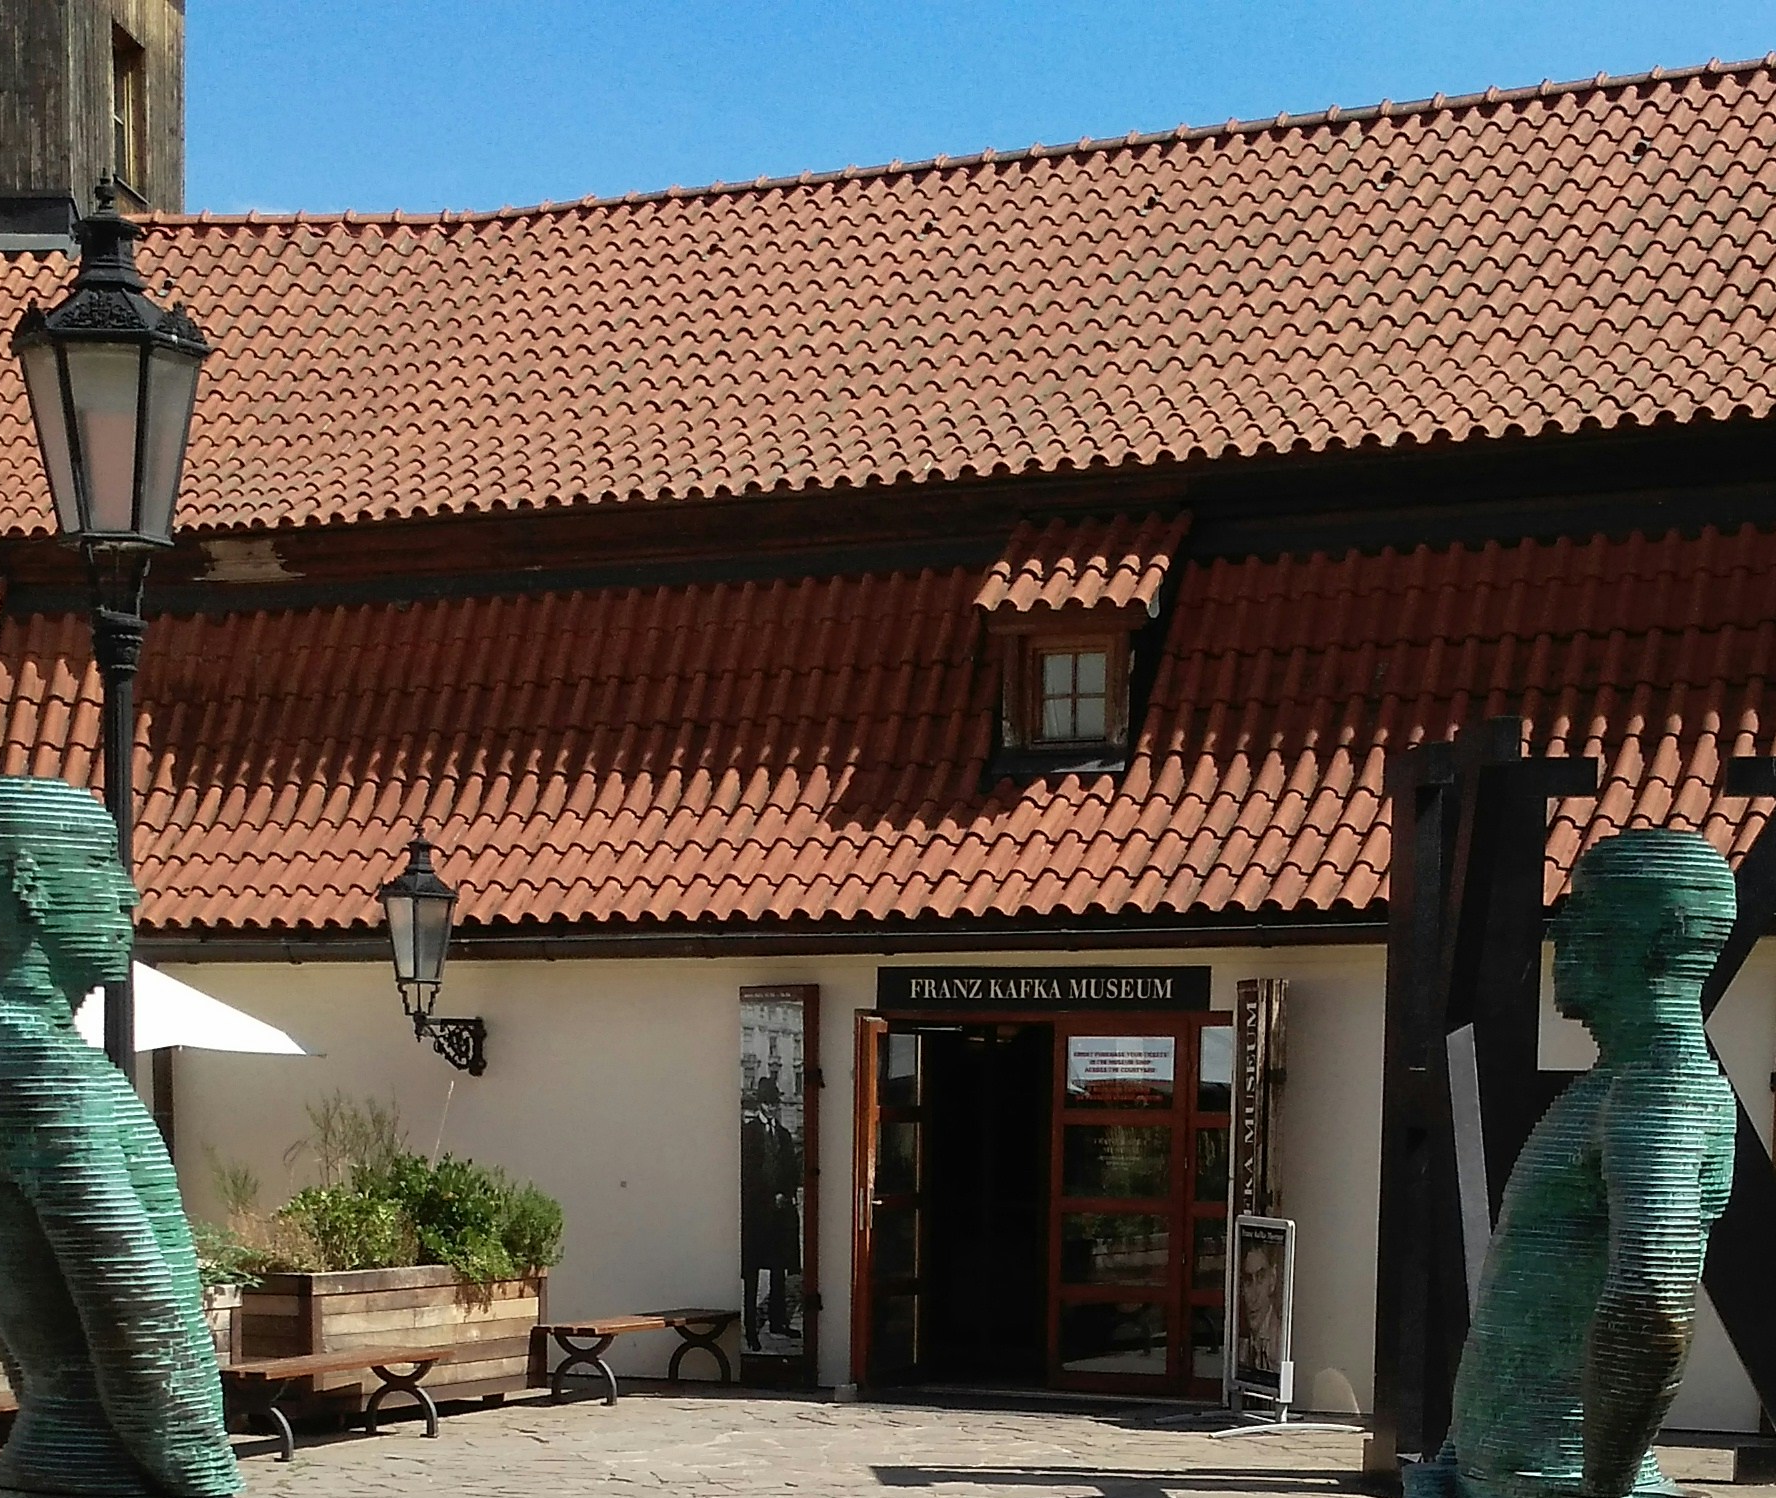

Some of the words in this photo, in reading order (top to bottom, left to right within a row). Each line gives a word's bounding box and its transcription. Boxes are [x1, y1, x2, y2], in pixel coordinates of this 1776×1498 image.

[909, 978, 983, 999] FRANZ
[989, 978, 1062, 999] KAFKA
[1068, 978, 1174, 999] MUSEUM
[1244, 1002, 1257, 1143] MUSEUM
